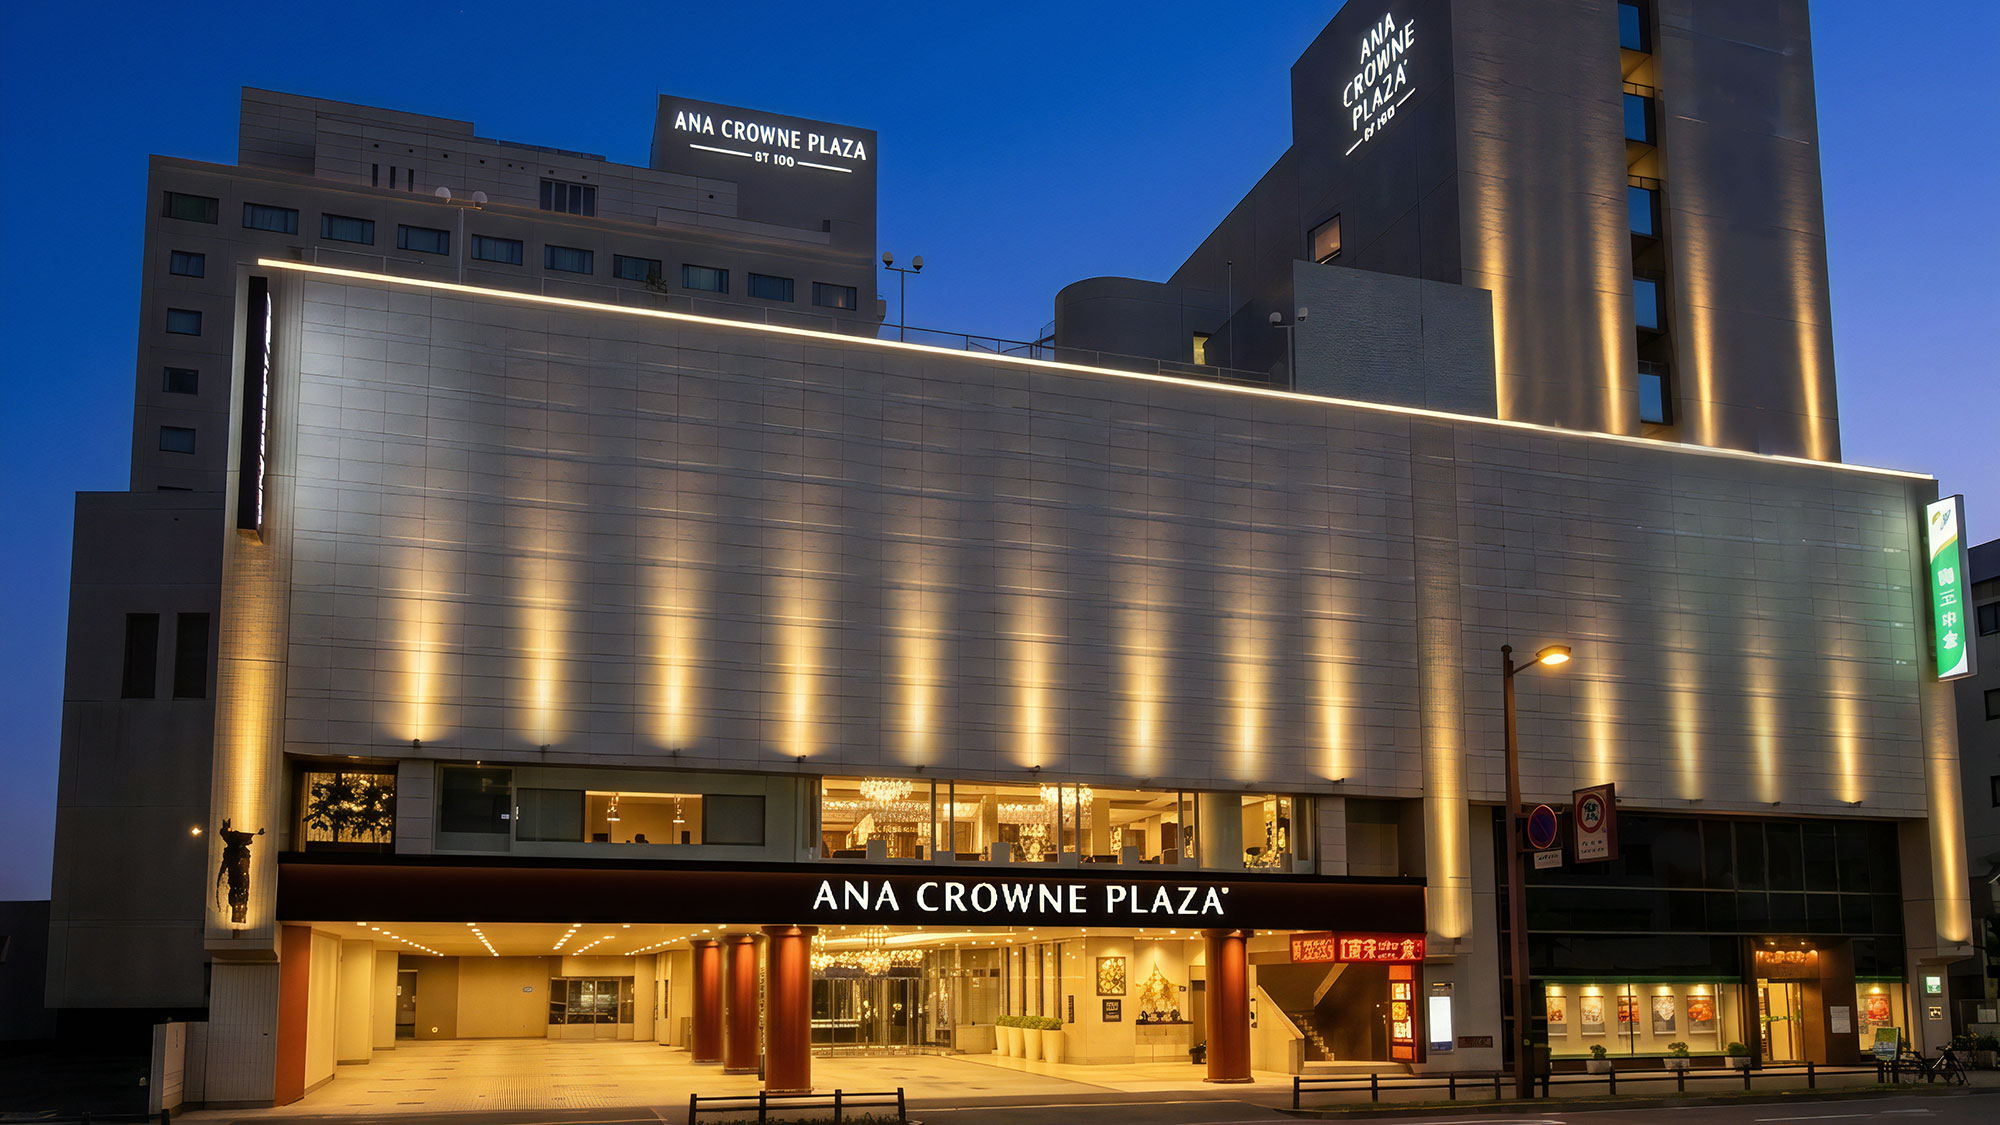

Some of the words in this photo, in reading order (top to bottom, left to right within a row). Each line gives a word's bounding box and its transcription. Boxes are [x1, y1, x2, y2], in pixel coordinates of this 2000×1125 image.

[1343, 18, 1415, 108] CROWNE
[1360, 12, 1396, 65] ANA
[1352, 63, 1407, 132] PLAZA
[674, 110, 715, 136] ANA
[721, 119, 801, 150] CROWNE
[808, 133, 867, 161] PLAZA
[813, 880, 900, 911] ANA
[916, 882, 1087, 913] CROWNE
[1106, 885, 1225, 915] PLAZA
